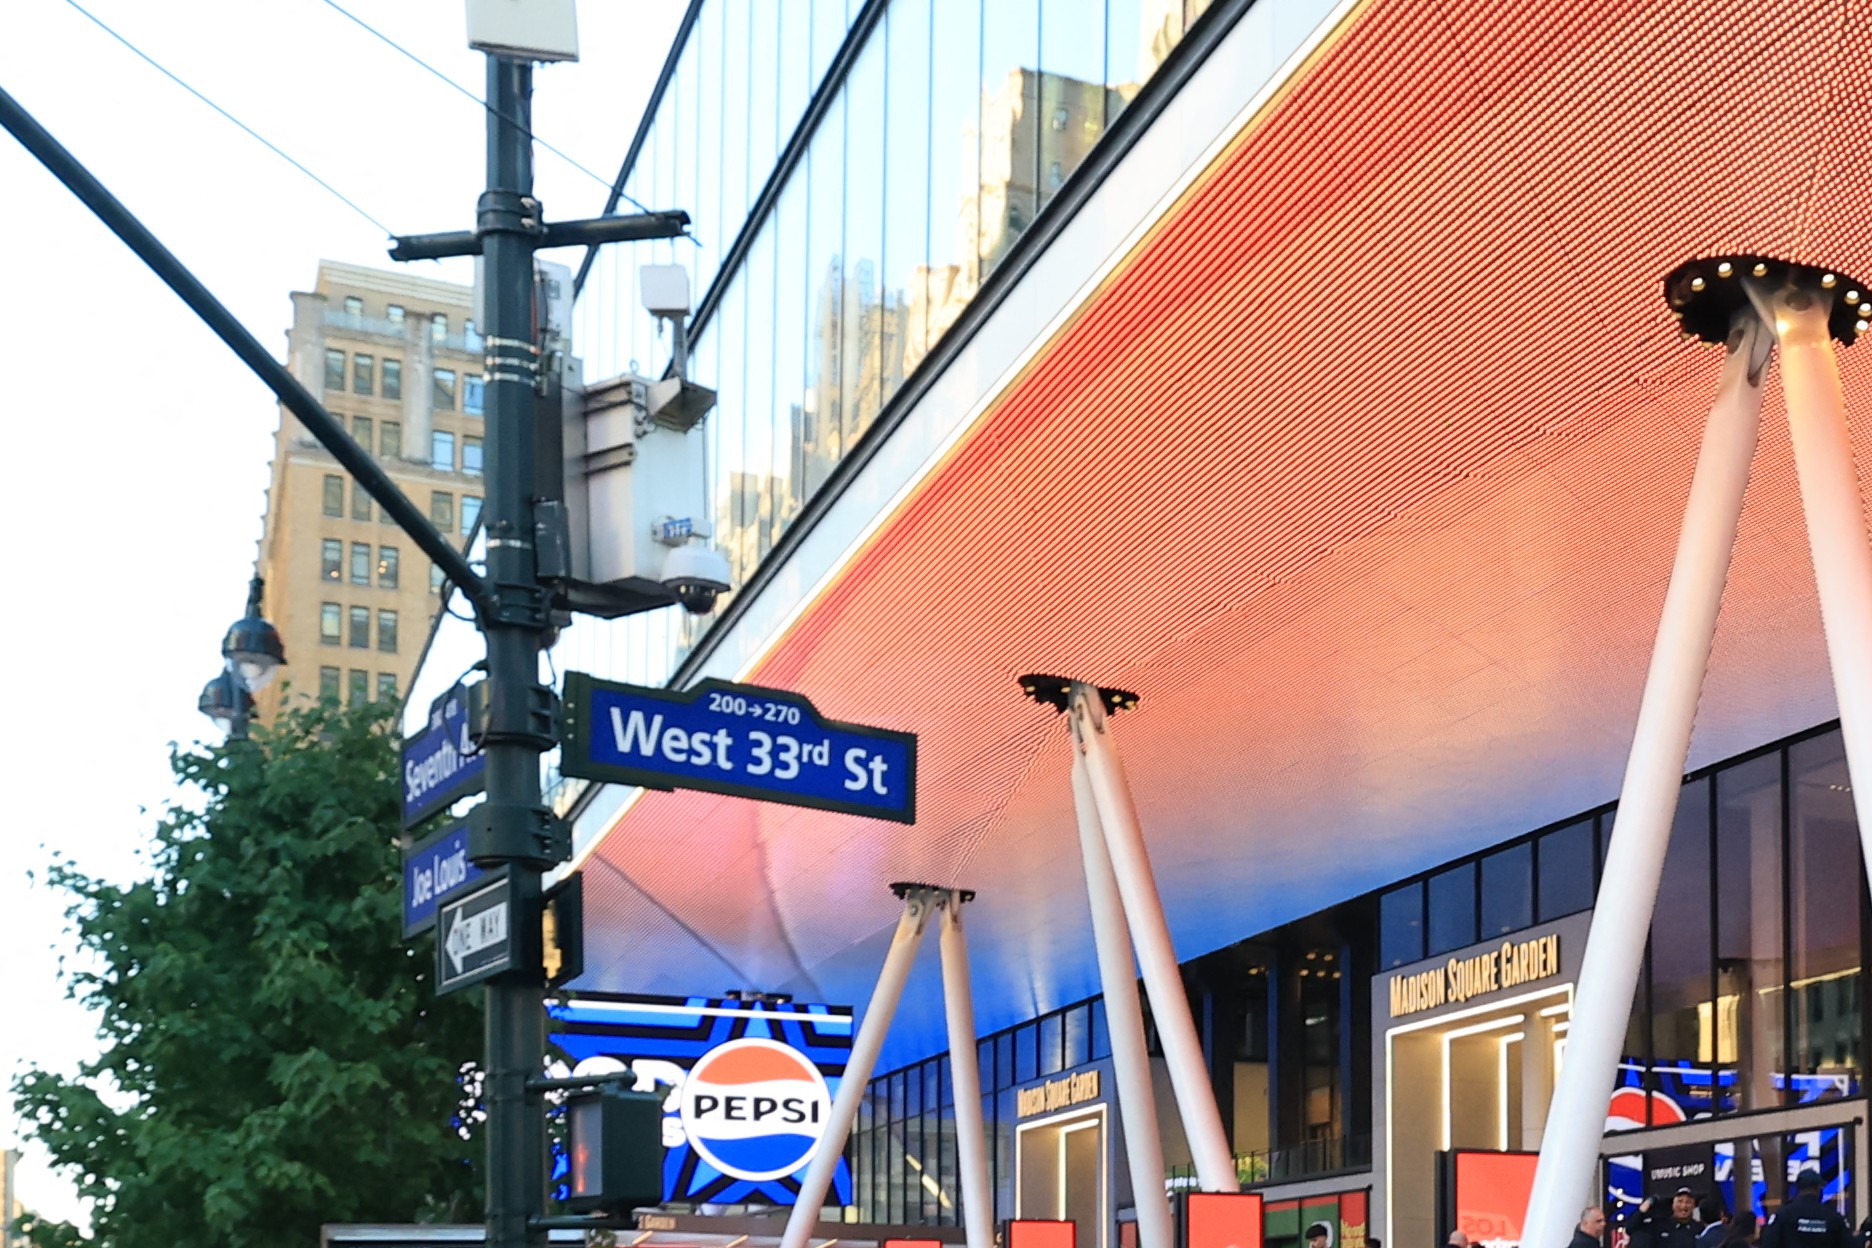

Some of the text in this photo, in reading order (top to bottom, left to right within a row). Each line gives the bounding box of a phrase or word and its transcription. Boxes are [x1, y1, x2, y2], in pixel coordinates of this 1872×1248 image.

[708, 692, 801, 726] 200 270
[405, 736, 459, 803] Seventh
[609, 706, 889, 796] West 33rd St
[412, 839, 467, 909] Joe Louis
[1389, 933, 1559, 1019] MADISON SQUARE GARDEN
[693, 1094, 820, 1124] PEPSI
[1682, 1162, 1705, 1177] SHOP
